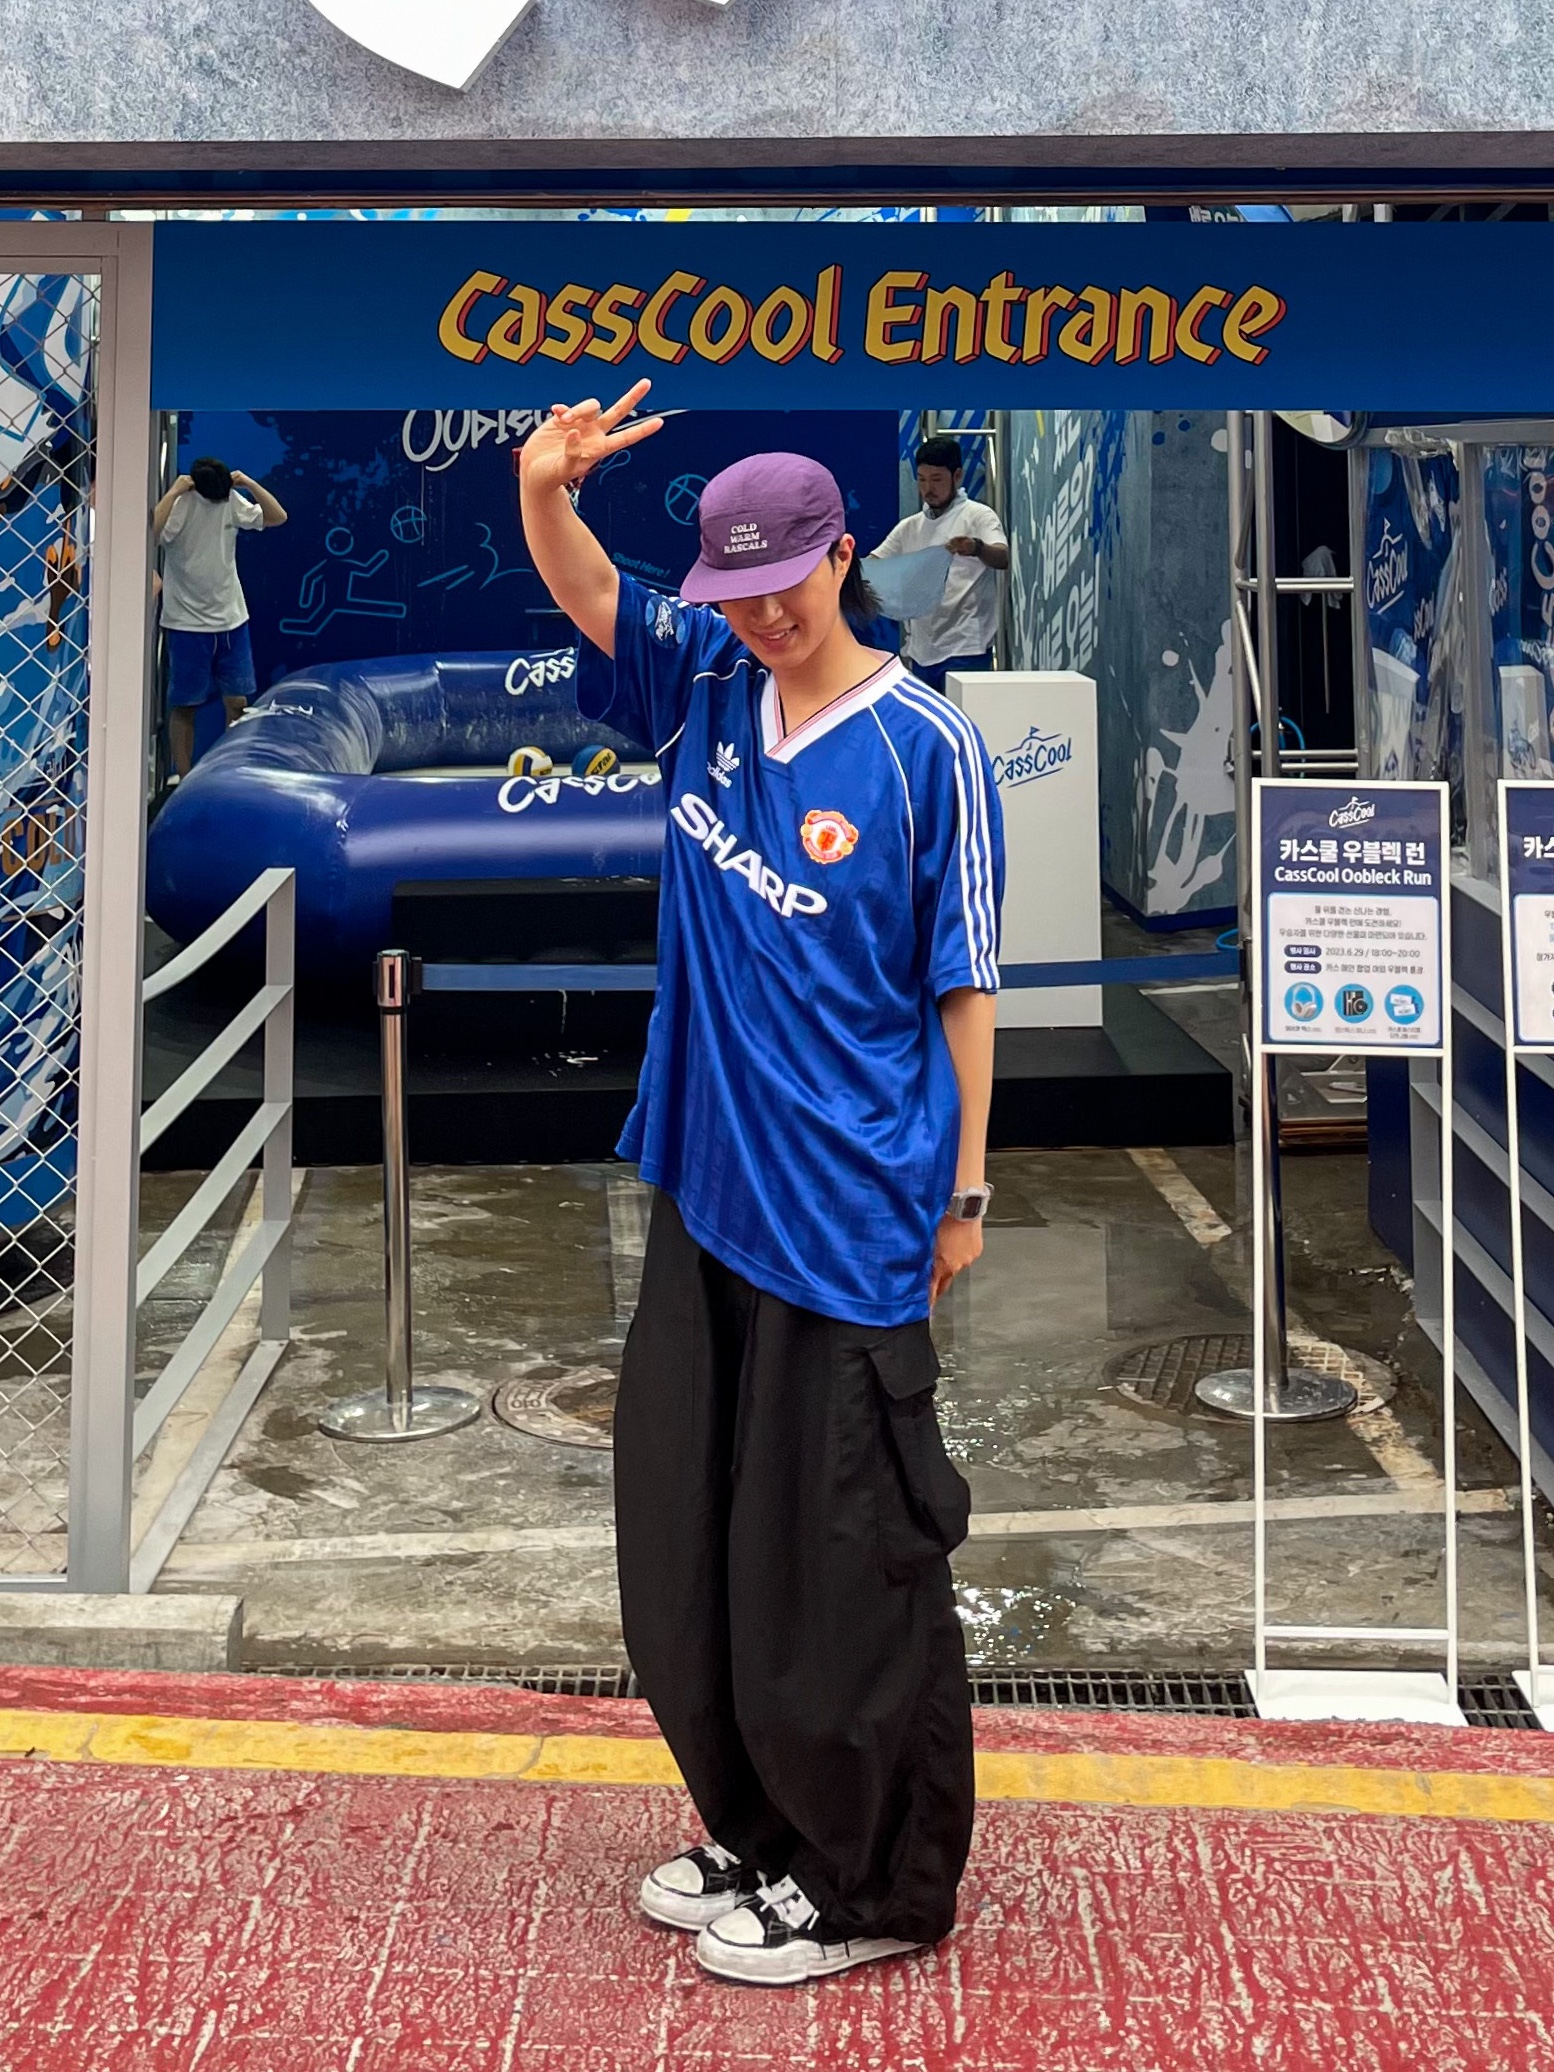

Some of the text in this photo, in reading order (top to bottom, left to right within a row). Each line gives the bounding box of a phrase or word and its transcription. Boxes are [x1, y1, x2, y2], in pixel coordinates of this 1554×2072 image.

[438, 263, 1287, 365] CassCool Entrance
[730, 532, 760, 543] WARM
[731, 523, 757, 534] COLD
[724, 540, 768, 554] RASCALS
[992, 737, 1072, 785] CassCool
[707, 761, 732, 788] adidas
[1329, 803, 1376, 828] CassCool
[670, 793, 828, 918] SHARP
[1279, 839, 1426, 866] 카스쿨 우블렉 런
[1274, 866, 1432, 886] CassCool Oobleck Run
[1325, 947, 1364, 957] 2023.6.29
